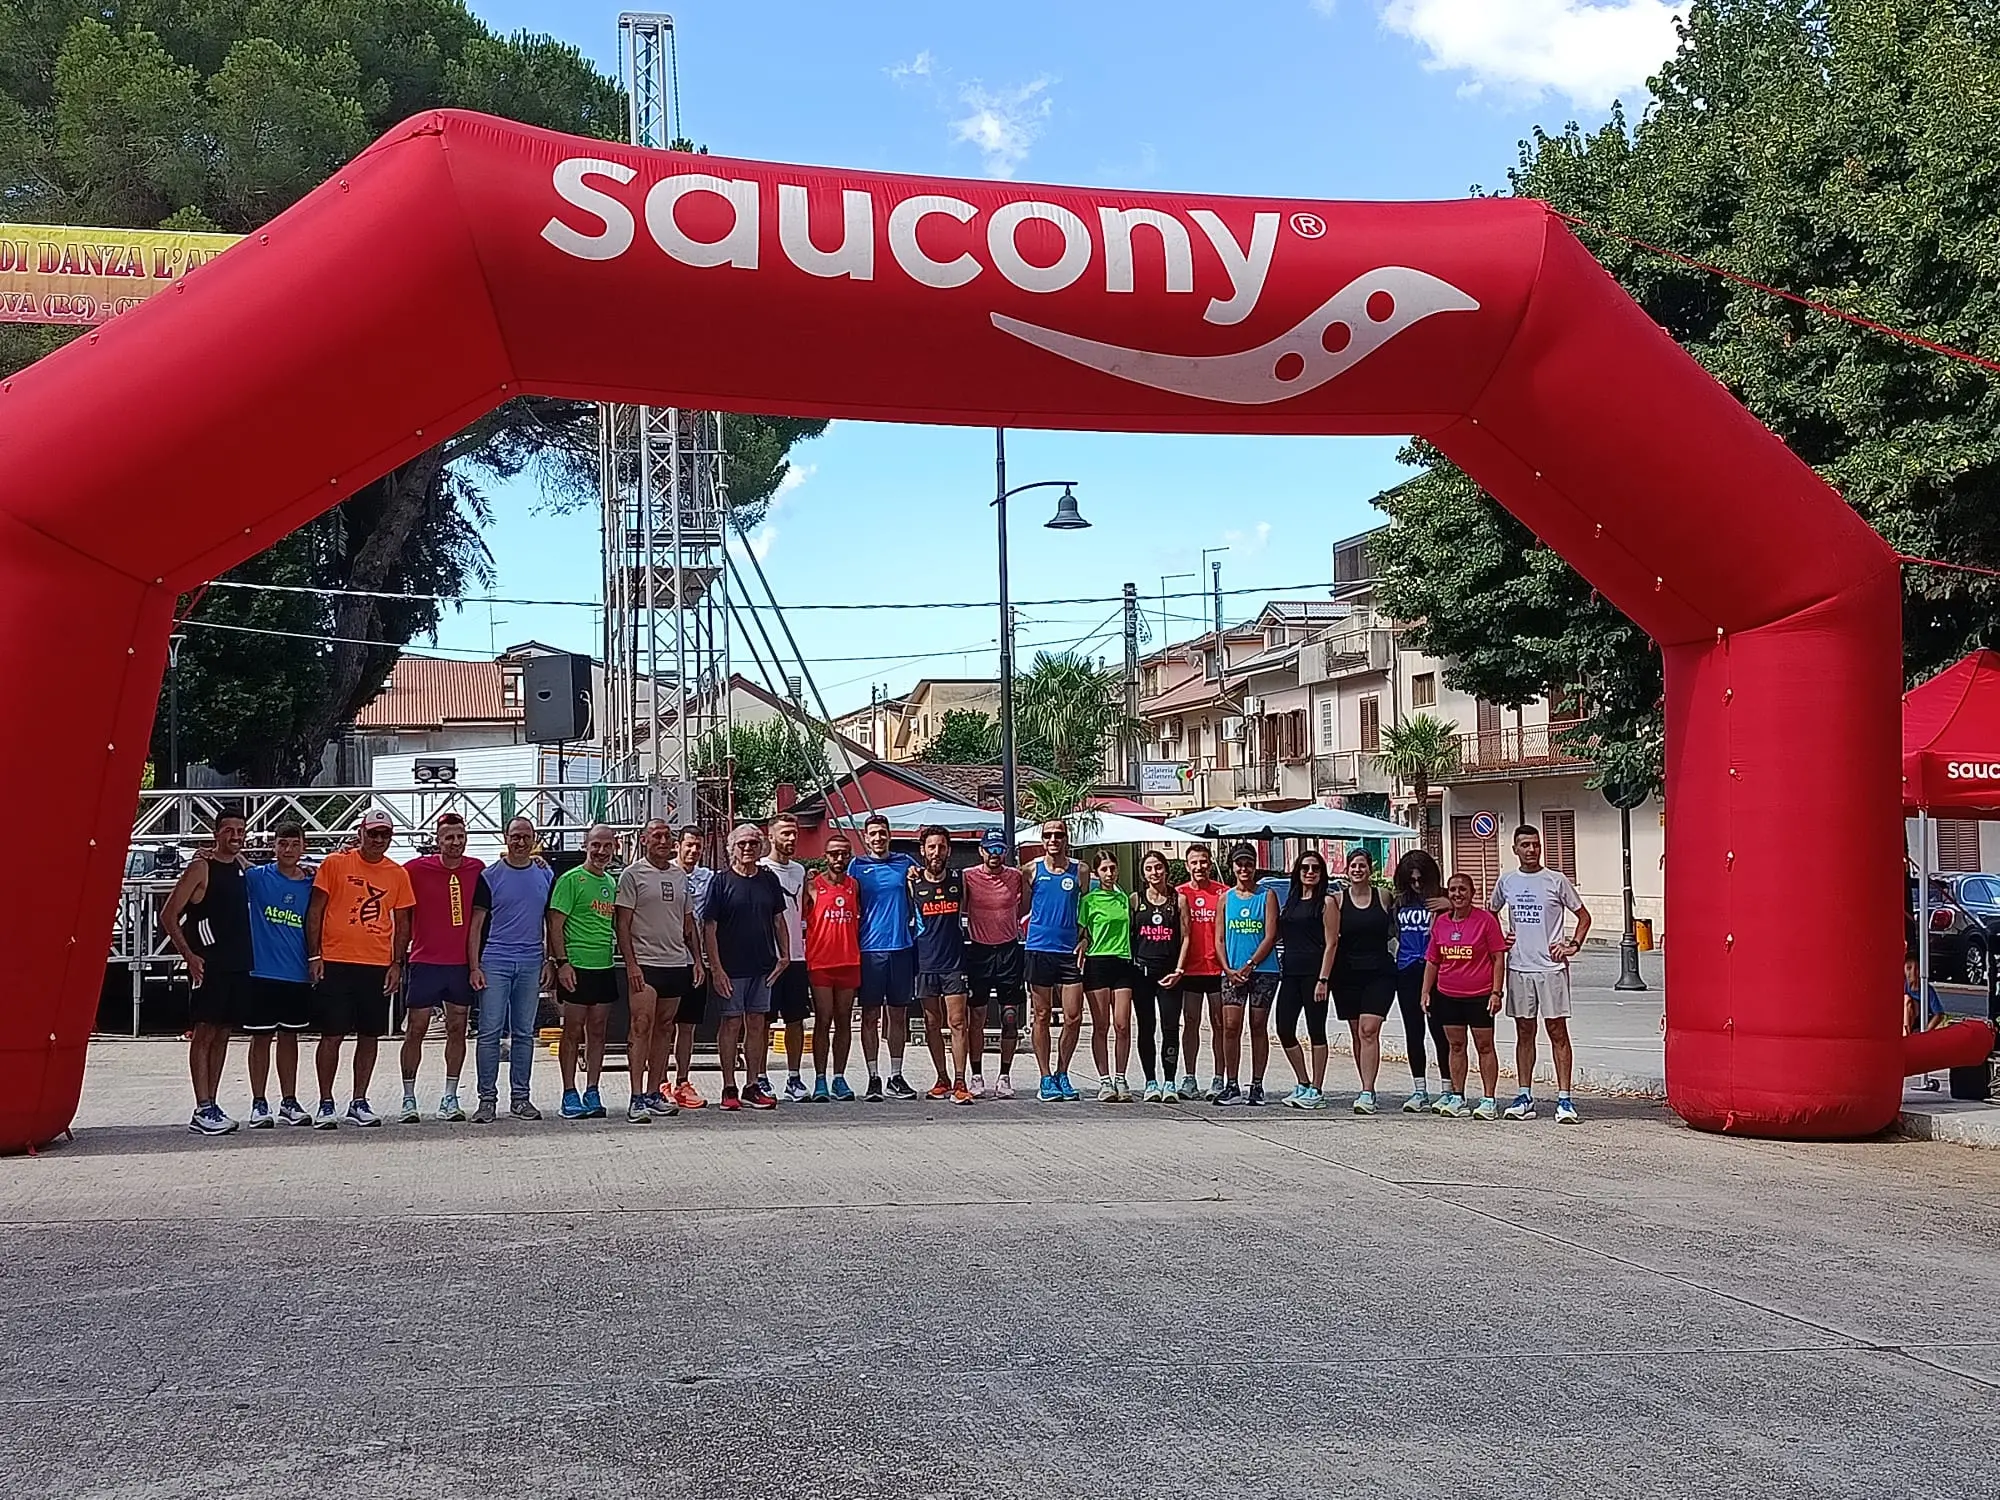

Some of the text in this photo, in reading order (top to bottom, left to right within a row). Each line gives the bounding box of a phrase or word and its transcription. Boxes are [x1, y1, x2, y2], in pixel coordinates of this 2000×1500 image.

[540, 156, 1282, 326] saucony
[38, 243, 146, 277] DANZA
[0, 293, 36, 313] VA
[43, 295, 96, 318] (RC)
[1947, 761, 2000, 779] sauc
[1229, 918, 1263, 929] Atelico
